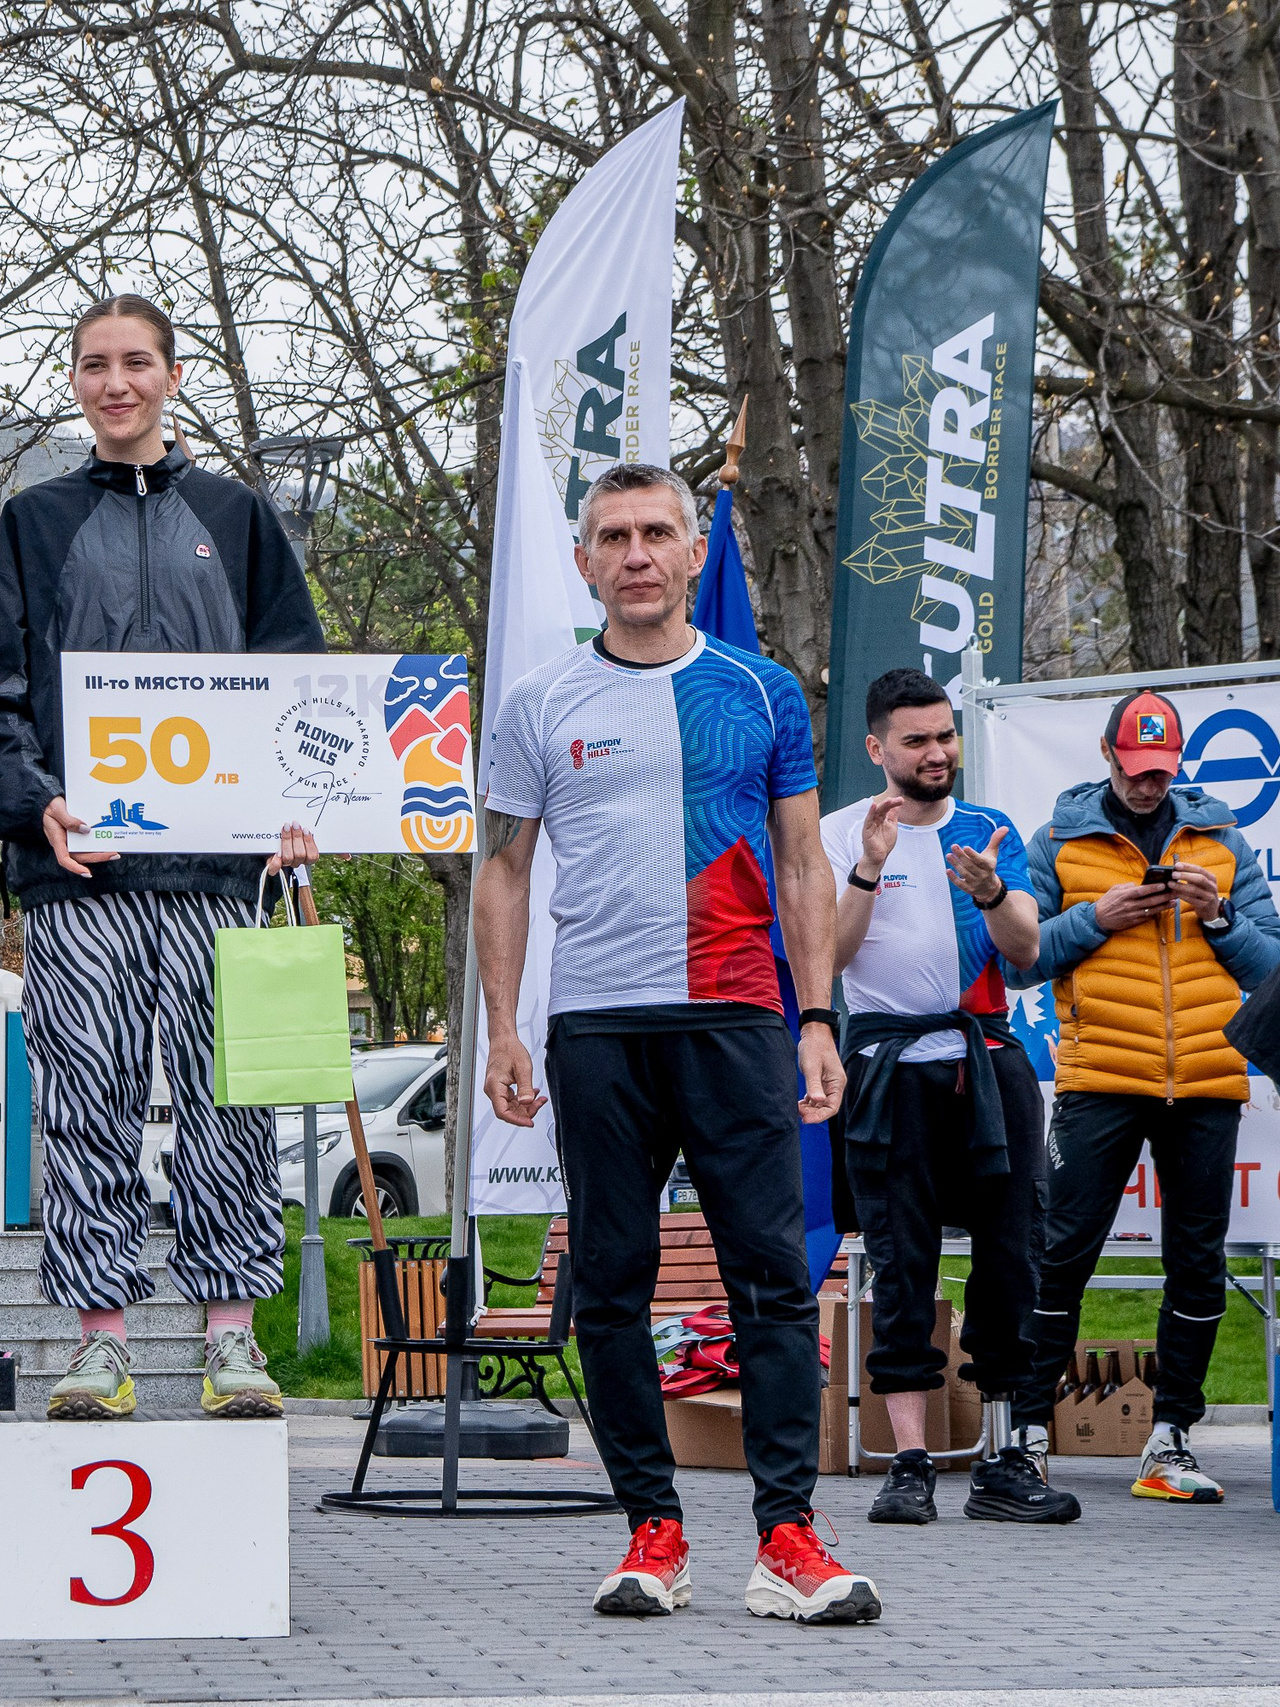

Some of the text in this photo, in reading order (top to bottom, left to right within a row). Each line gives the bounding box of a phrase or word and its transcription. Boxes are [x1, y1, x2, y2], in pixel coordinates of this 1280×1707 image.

[624, 339, 640, 464] RDER RACE
[978, 341, 1008, 654] GOLD BORDER RACE
[135, 676, 205, 691] МЯСТО
[209, 676, 270, 691] ЖЕНИ
[293, 674, 390, 718] 12K
[275, 698, 369, 767] PLOVDIV HILLS IN MARKOVO
[294, 720, 354, 754] PLOVDIV
[587, 738, 621, 750] PLOVDIV
[89, 716, 240, 785] 50 лв
[298, 740, 337, 767] HILLS
[587, 748, 610, 759] HILLS
[275, 750, 348, 789] TRAIL RUN RACE
[95, 830, 112, 839] ECO
[231, 831, 282, 840] www.eco-st
[489, 1167, 562, 1183] WWW.K
[1076, 1423, 1095, 1437] hills
[70, 1459, 154, 1607] 3
